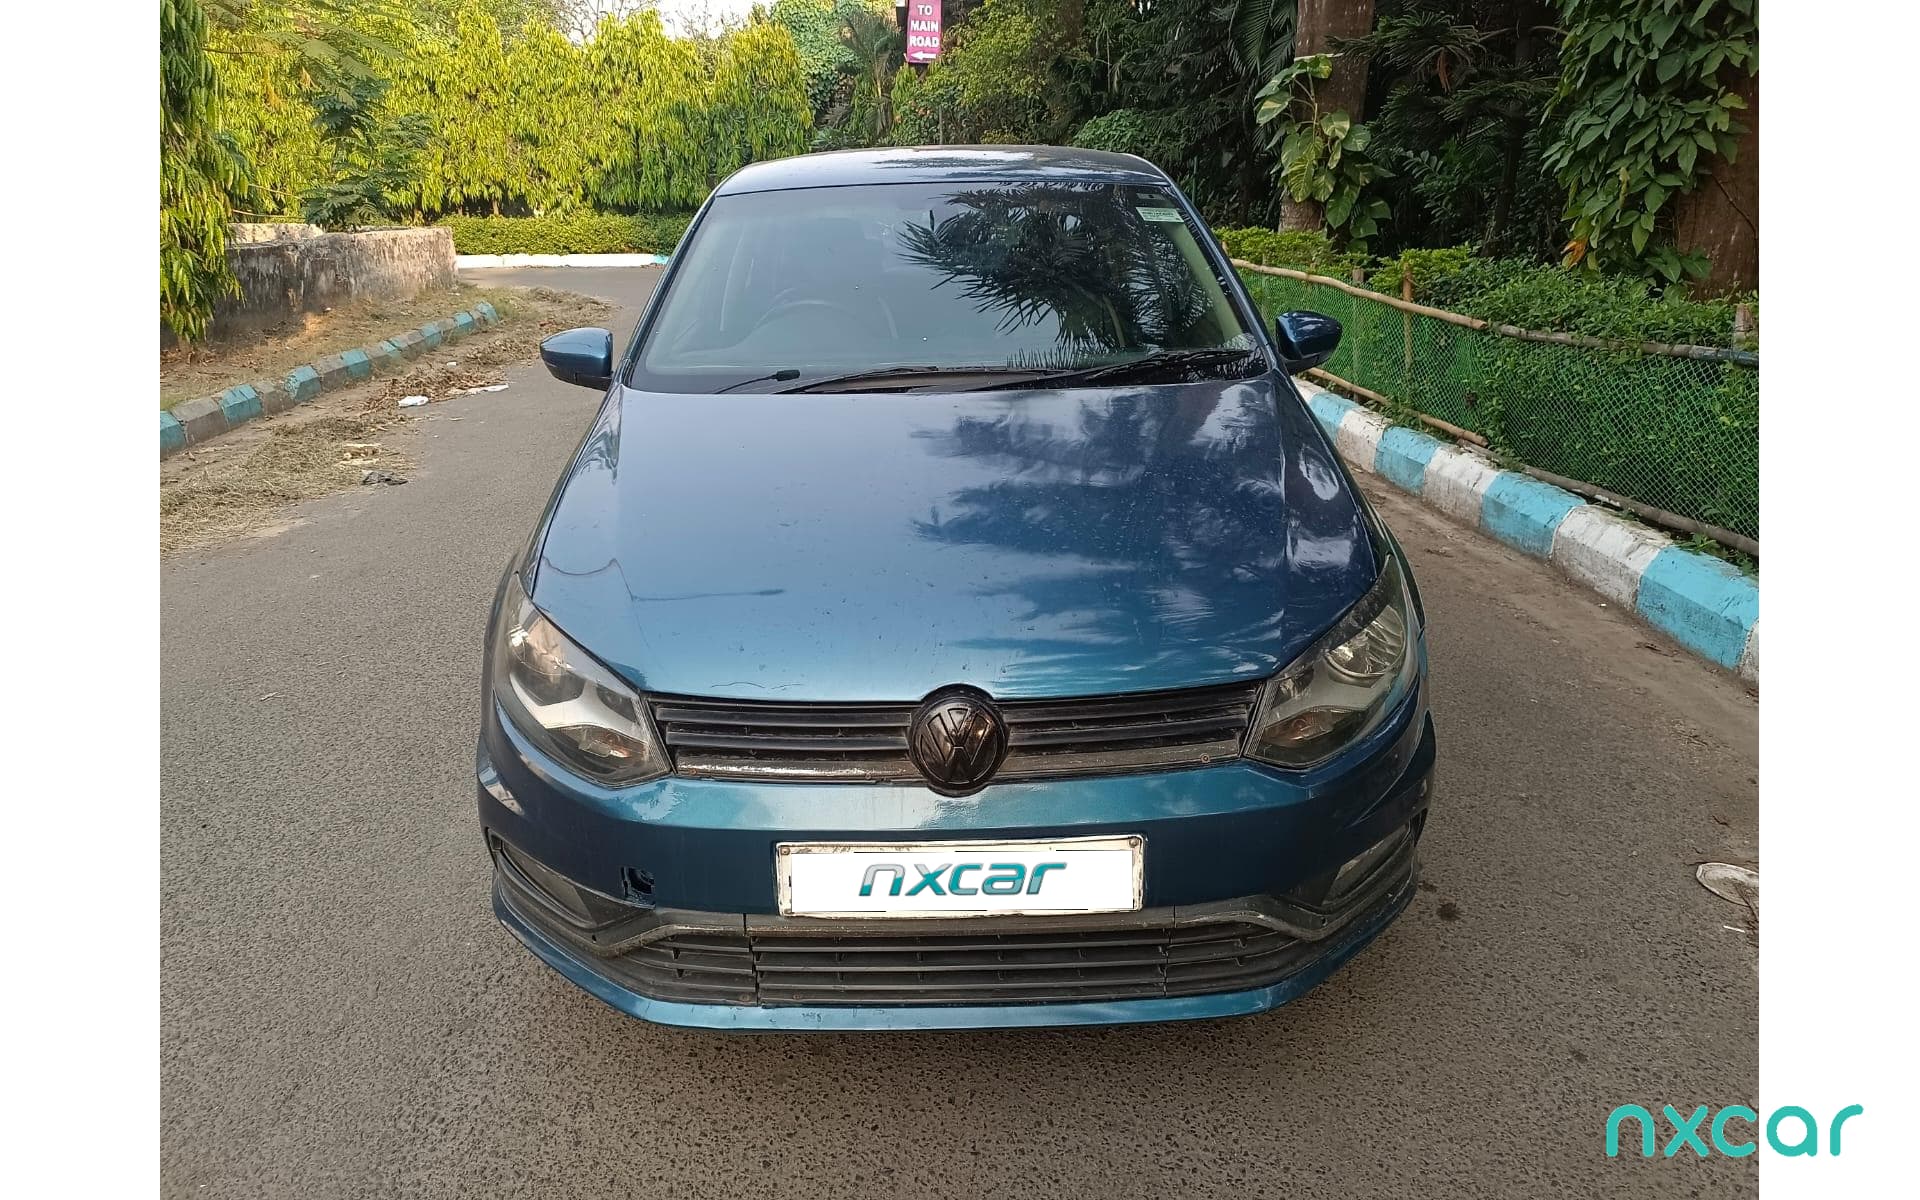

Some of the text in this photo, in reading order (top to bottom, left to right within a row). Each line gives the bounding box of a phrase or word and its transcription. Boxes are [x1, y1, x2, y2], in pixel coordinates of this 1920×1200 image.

[917, 4, 933, 16] TO
[910, 20, 939, 32] MAIN
[910, 35, 940, 48] ROAD
